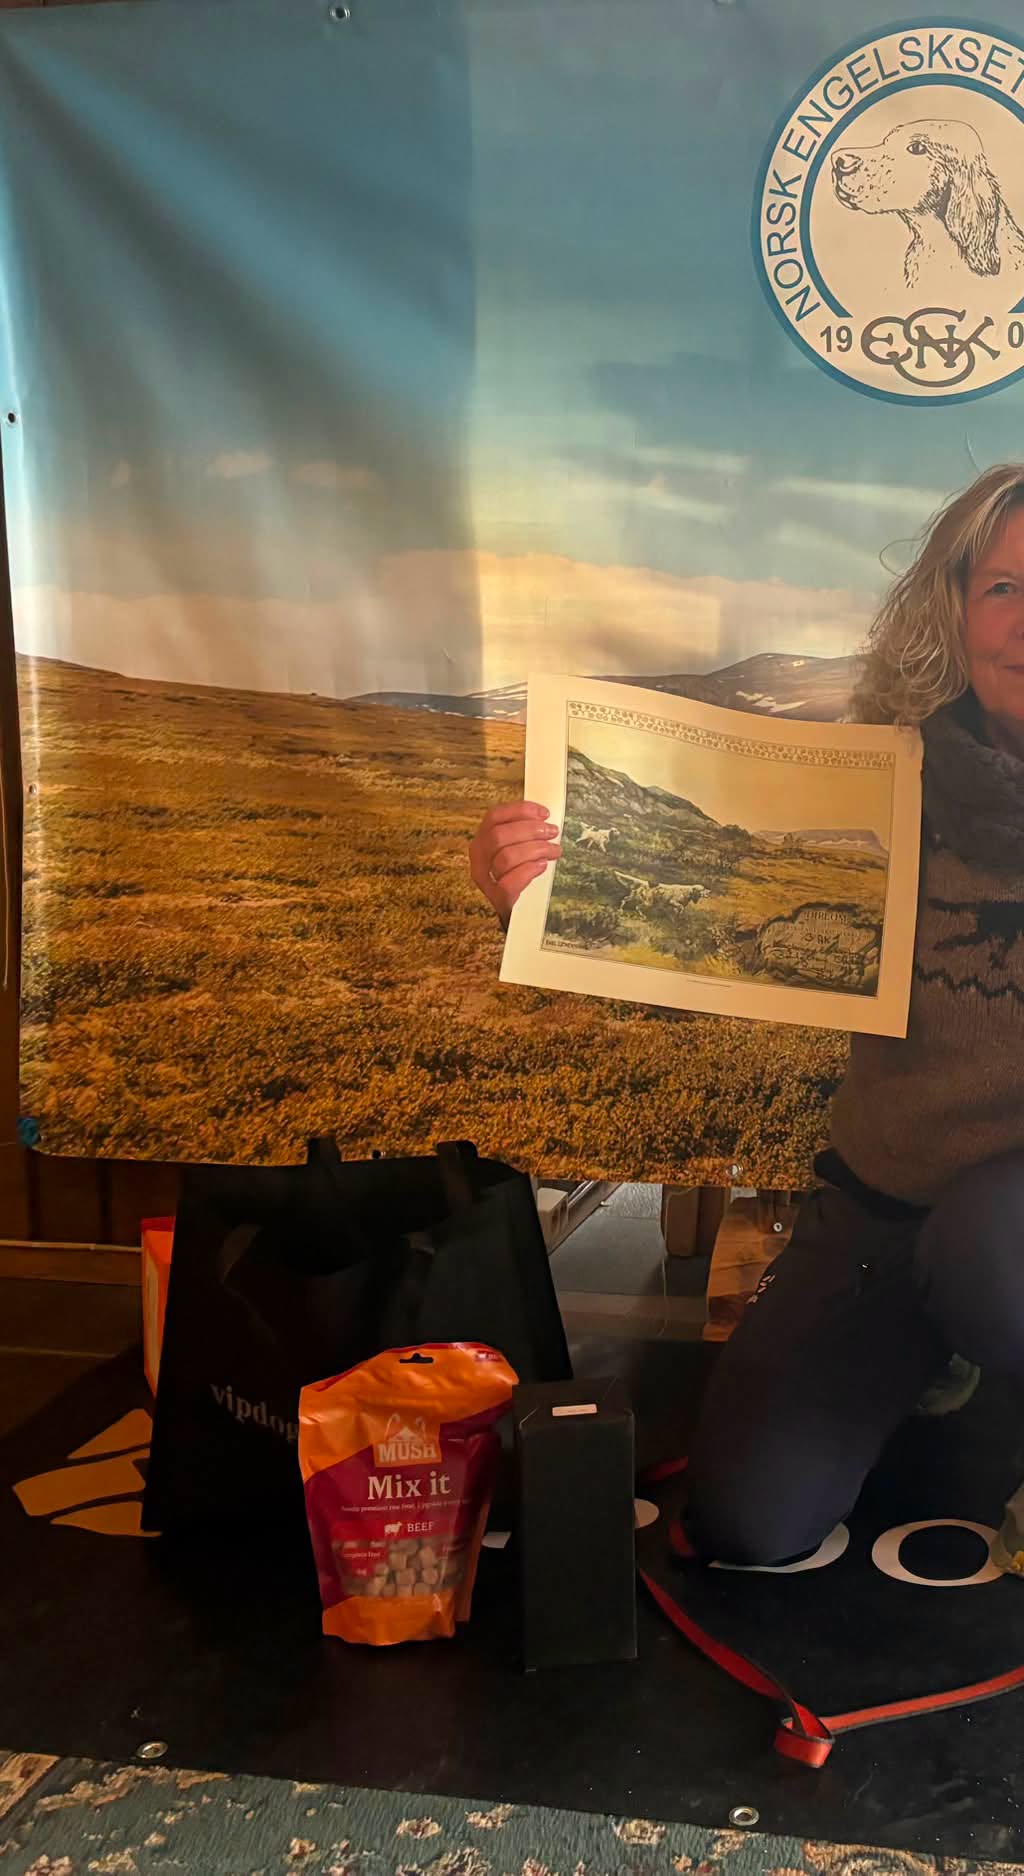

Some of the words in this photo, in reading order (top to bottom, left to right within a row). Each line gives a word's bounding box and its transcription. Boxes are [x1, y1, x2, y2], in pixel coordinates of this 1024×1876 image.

[766, 169, 821, 322] NORSK
[820, 325, 852, 353] 19
[377, 1441, 437, 1464] MUSH
[368, 1474, 423, 1500] Mix
[429, 1471, 453, 1496] it
[407, 1521, 434, 1533] BEEF
